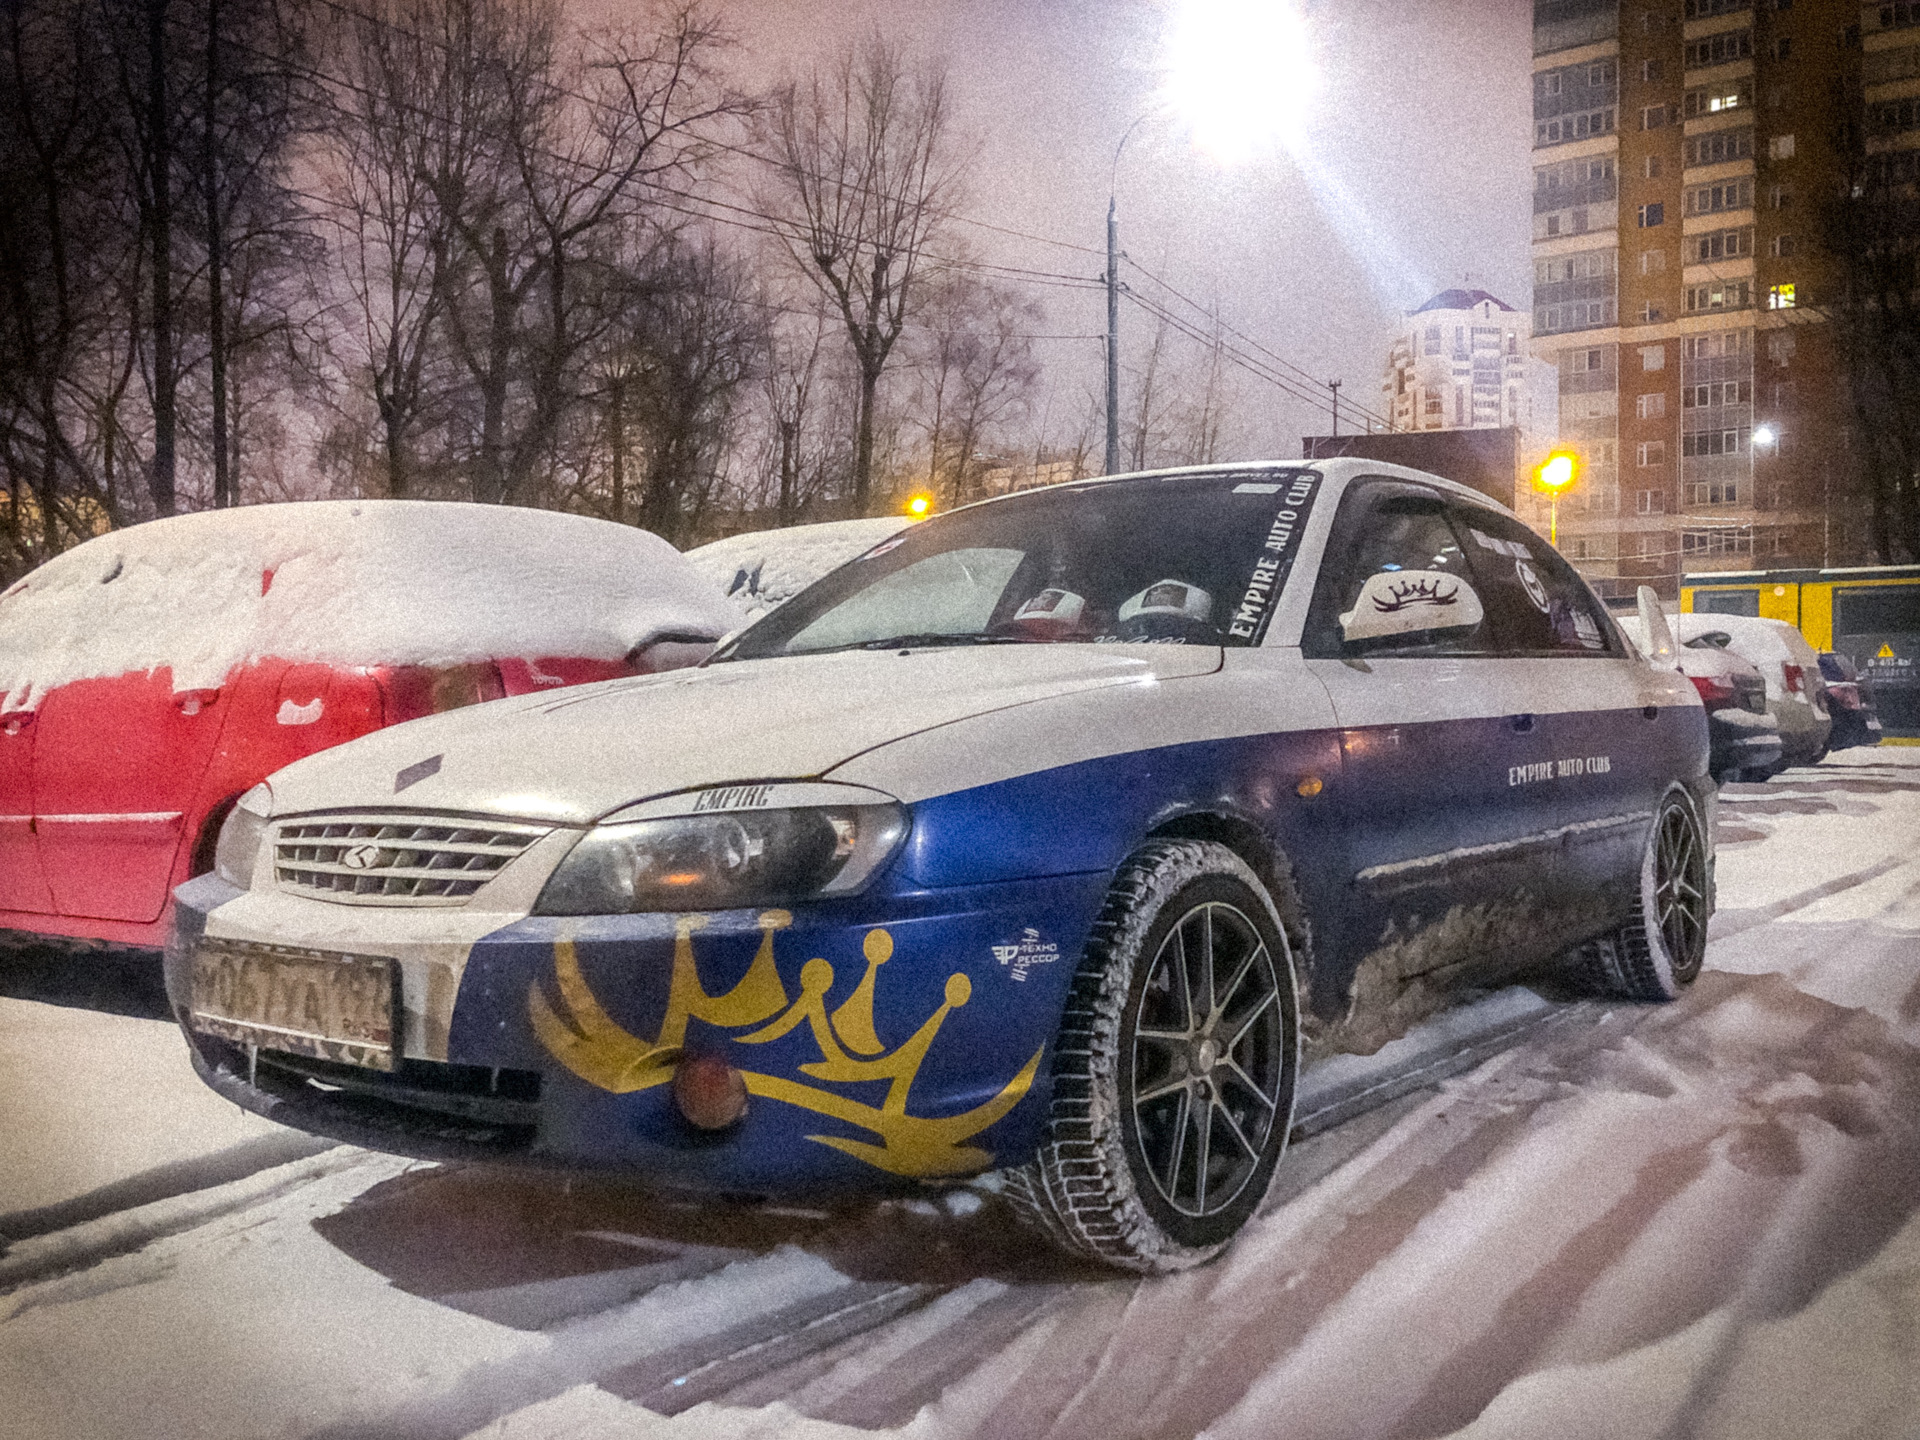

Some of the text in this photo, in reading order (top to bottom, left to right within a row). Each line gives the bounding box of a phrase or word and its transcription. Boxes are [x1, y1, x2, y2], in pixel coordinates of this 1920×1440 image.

[1229, 474, 1317, 639] EMPIRE AUTO CLUB
[1508, 756, 1611, 787] EMPIRE AUTO CLUB
[692, 785, 774, 812] EMPIRE
[1017, 954, 1060, 964] РЕССОР
